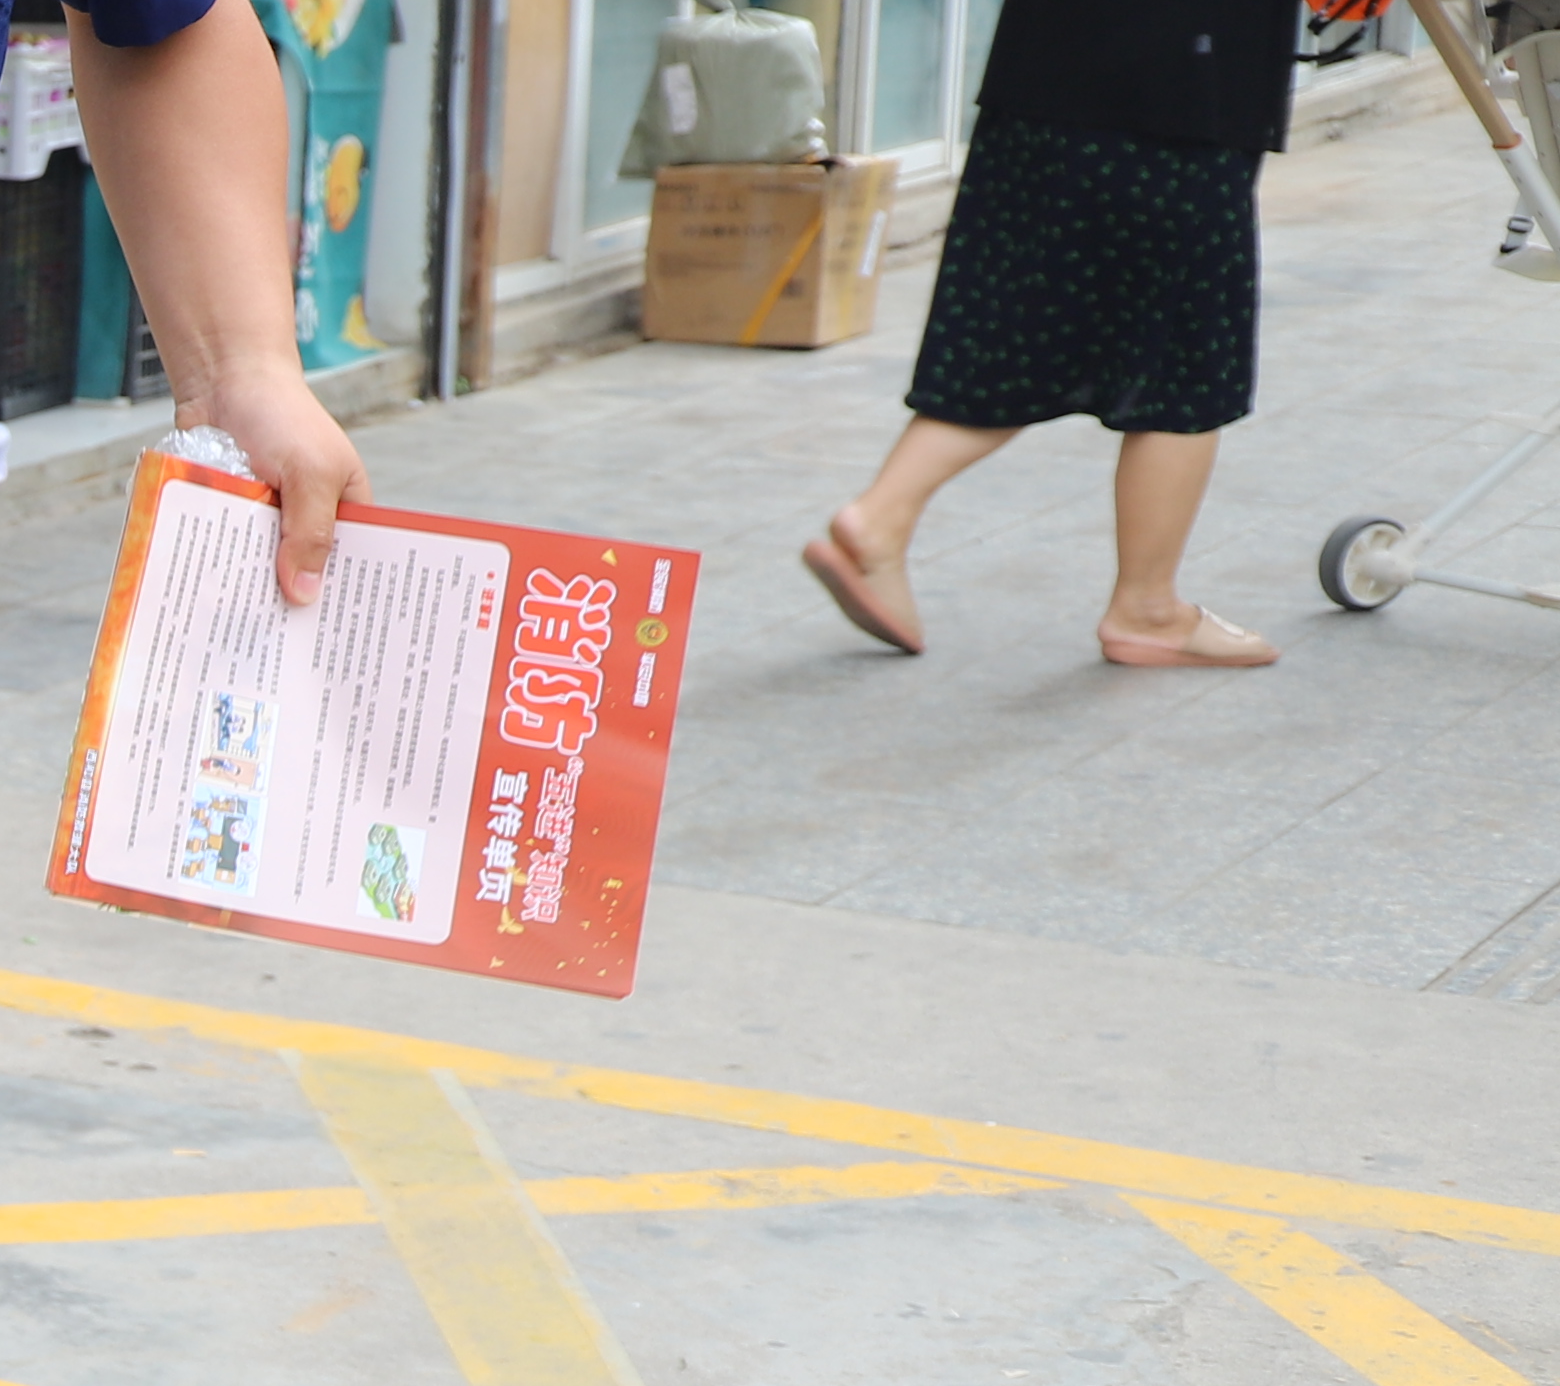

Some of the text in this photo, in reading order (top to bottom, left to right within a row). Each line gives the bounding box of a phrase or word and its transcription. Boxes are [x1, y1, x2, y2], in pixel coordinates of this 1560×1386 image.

[500, 568, 616, 755] 消防
[476, 768, 528, 903] 宣传单页
